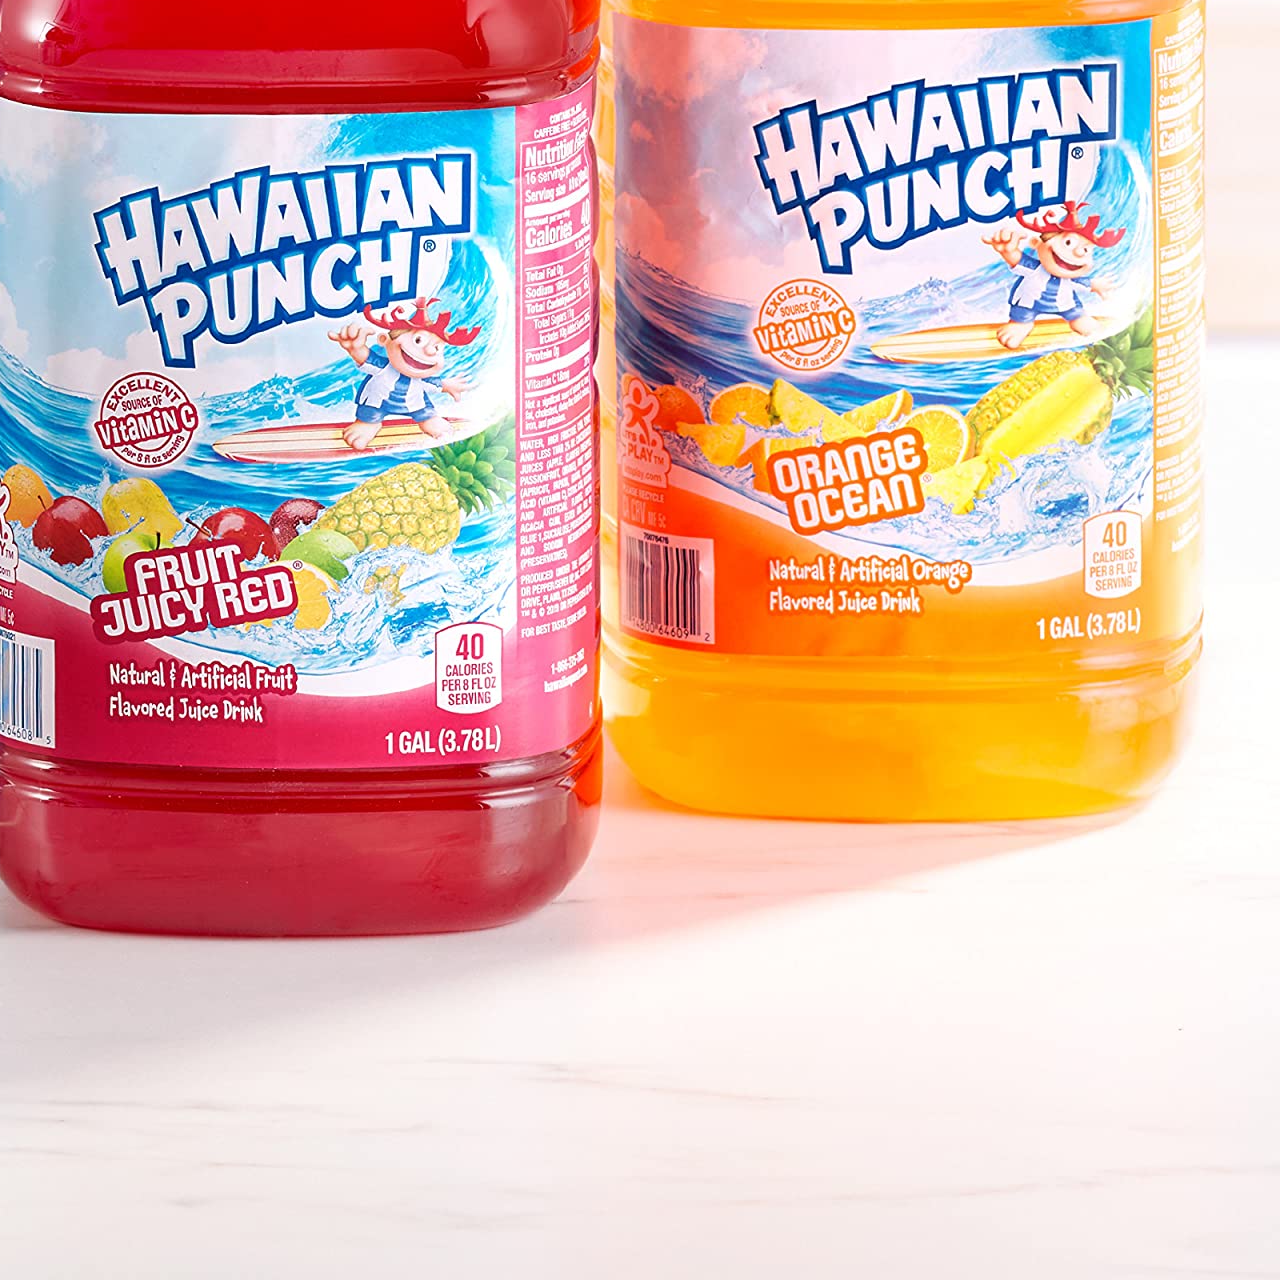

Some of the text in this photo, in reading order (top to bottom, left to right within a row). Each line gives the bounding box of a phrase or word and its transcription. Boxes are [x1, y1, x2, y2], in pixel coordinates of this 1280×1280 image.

[754, 63, 1118, 215] HAWAIIAN
[525, 138, 575, 167] Nutrition
[525, 170, 537, 185] 16
[525, 185, 555, 203] Serving
[93, 153, 472, 306] HAWAIIAN
[525, 220, 573, 249] Calories
[525, 269, 545, 283] Total
[525, 282, 554, 298] Sodium
[765, 285, 838, 318] EXCELLENT
[780, 300, 820, 318] SOURCE OF
[836, 307, 856, 335] C
[525, 348, 552, 364] Protein
[780, 351, 795, 362] per
[107, 379, 180, 412] EXCELLENT
[525, 374, 551, 391] Vitamin
[122, 394, 162, 412] SOURCE OF
[177, 402, 198, 431] C
[121, 435, 185, 464] per 8 fl oz serving
[773, 434, 921, 494] ORANGE
[793, 473, 917, 528] OCEAN
[1102, 521, 1127, 548] 40
[1092, 548, 1135, 564] CALORIES
[134, 544, 242, 595] FRUIT
[769, 556, 825, 582] Natural
[840, 556, 910, 582] Artificial
[913, 561, 969, 589] Orange
[1089, 561, 1138, 578] PER 8 FL OZ
[1095, 576, 1133, 592] SERVING
[100, 571, 294, 637] JUICY RED
[769, 586, 834, 613] Flavored
[838, 588, 877, 613] Juice
[704, 632, 711, 642] 2
[1036, 618, 1045, 640] 1
[1049, 616, 1085, 640] GAL
[455, 632, 484, 660] 40
[109, 661, 166, 687] Natural
[181, 662, 252, 690] Artificial
[256, 665, 294, 690] Fruit
[445, 662, 493, 677] CALORIES
[442, 676, 496, 692] PER 8 FL OZ
[109, 691, 175, 722] Flavored
[179, 696, 219, 721] Juice
[448, 691, 491, 706] SERVING
[45, 735, 51, 745] 5
[385, 731, 394, 755] 1
[398, 730, 436, 754] GAL
